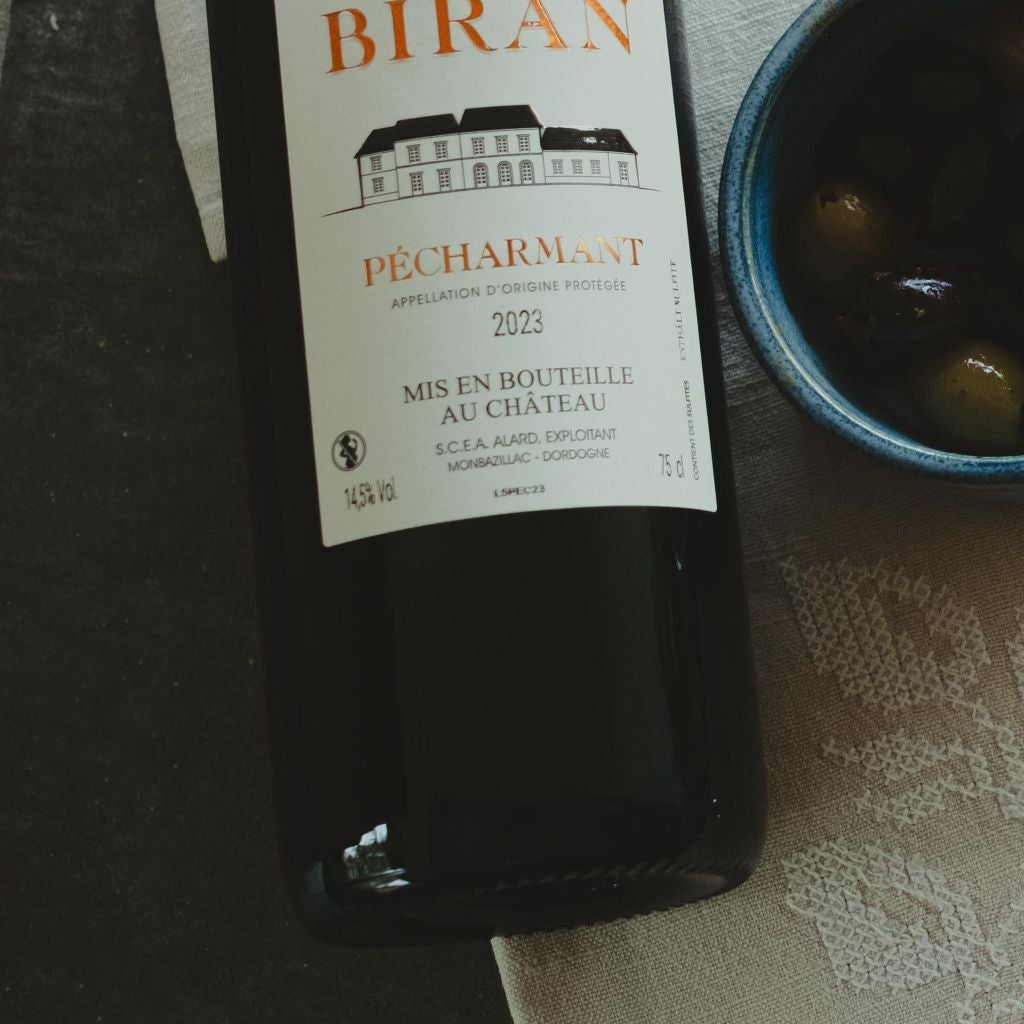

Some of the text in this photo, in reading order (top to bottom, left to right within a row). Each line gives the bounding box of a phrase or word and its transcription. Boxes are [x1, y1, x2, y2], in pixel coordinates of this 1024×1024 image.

[363, 236, 644, 287] PÉCHARMANT
[392, 278, 627, 309] APPELLATION D'ORIGINE PROTÉGÉE
[492, 309, 543, 337] 2023
[402, 366, 634, 404] MIS EN BOUTEILLE
[441, 392, 606, 425] AU CHÂTEAU
[493, 432, 542, 448] ALARD,
[545, 428, 617, 443] EXPLOITANT
[683, 380, 699, 480] CONTIENT DES SULFITES
[448, 451, 531, 472] MONBAZILLAC
[542, 447, 610, 463] DORDOGNE
[658, 453, 685, 478] 75 cl
[344, 482, 376, 512] 14,5%
